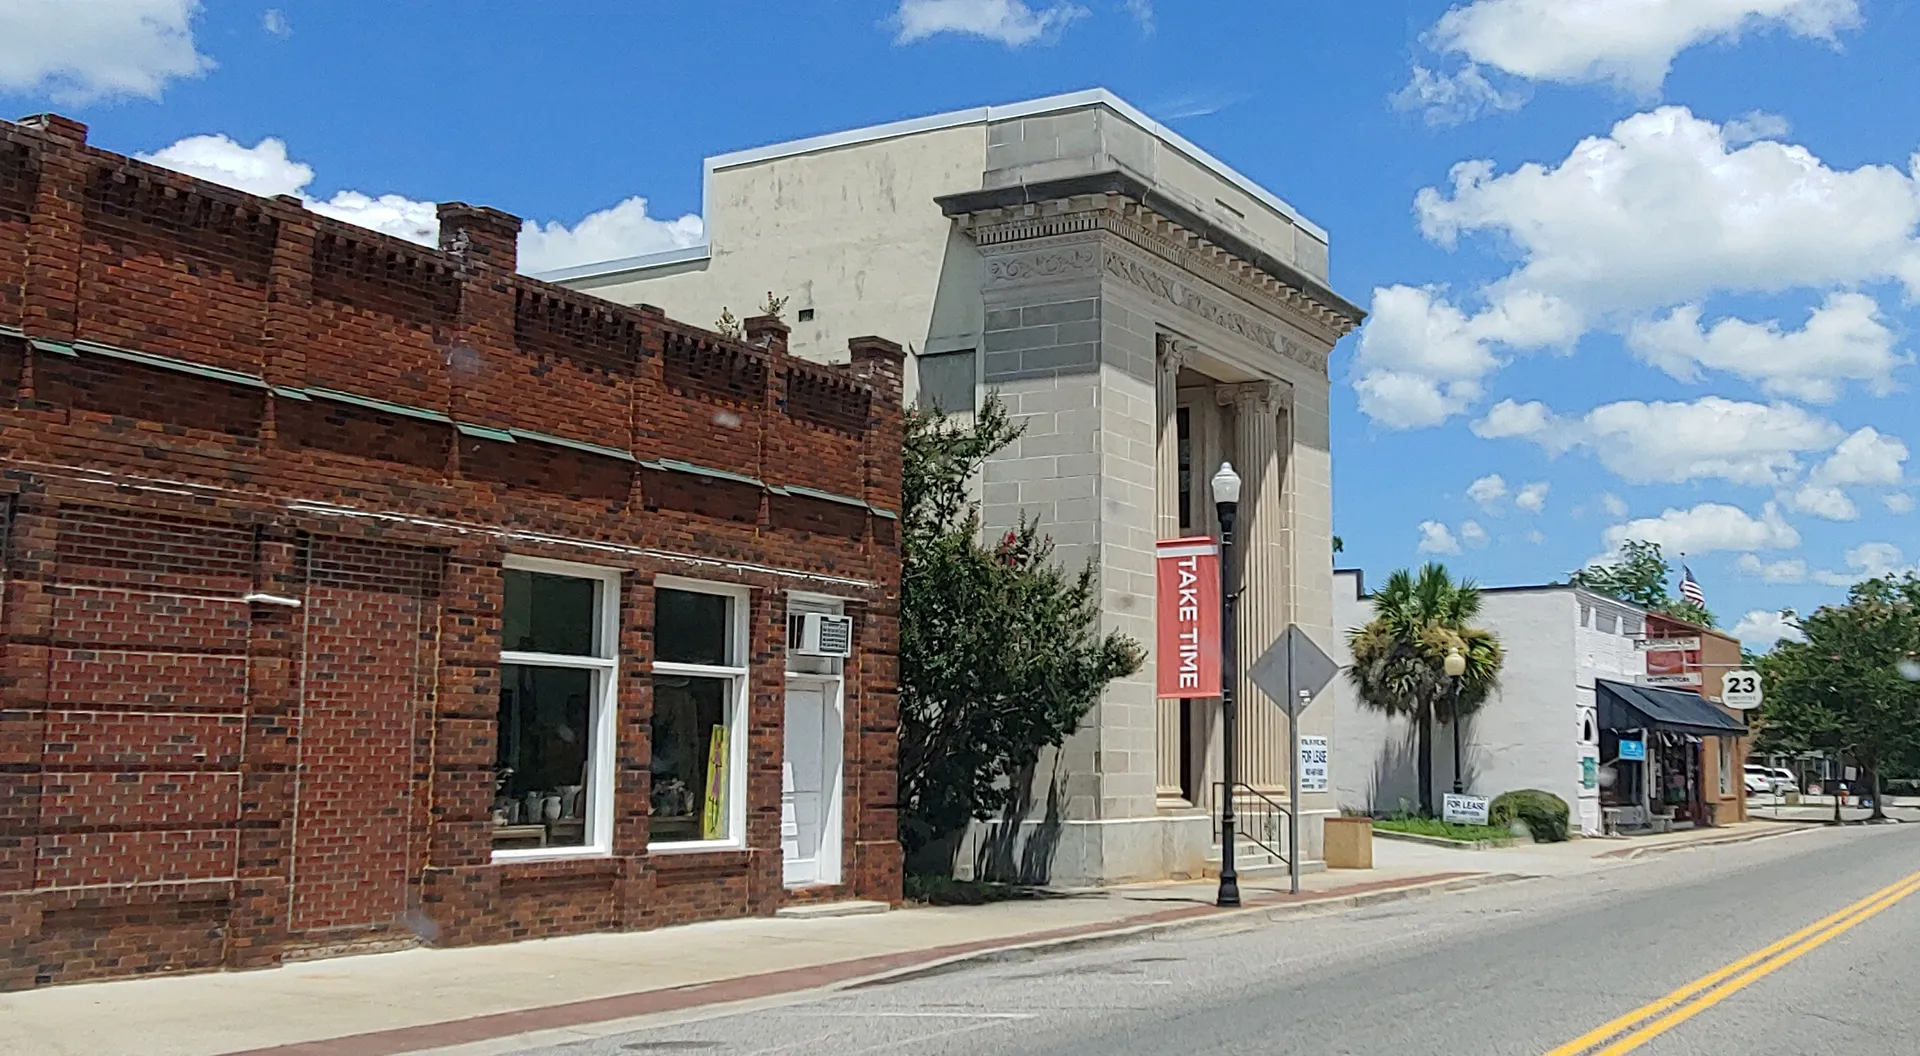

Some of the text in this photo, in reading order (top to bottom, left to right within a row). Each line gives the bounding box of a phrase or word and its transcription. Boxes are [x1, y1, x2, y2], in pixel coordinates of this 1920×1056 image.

[1178, 556, 1198, 689] TAKE TIME
[1728, 677, 1756, 693] 23
[1301, 750, 1327, 763] FOR LEASE
[1447, 800, 1486, 811] FOR LEASE
